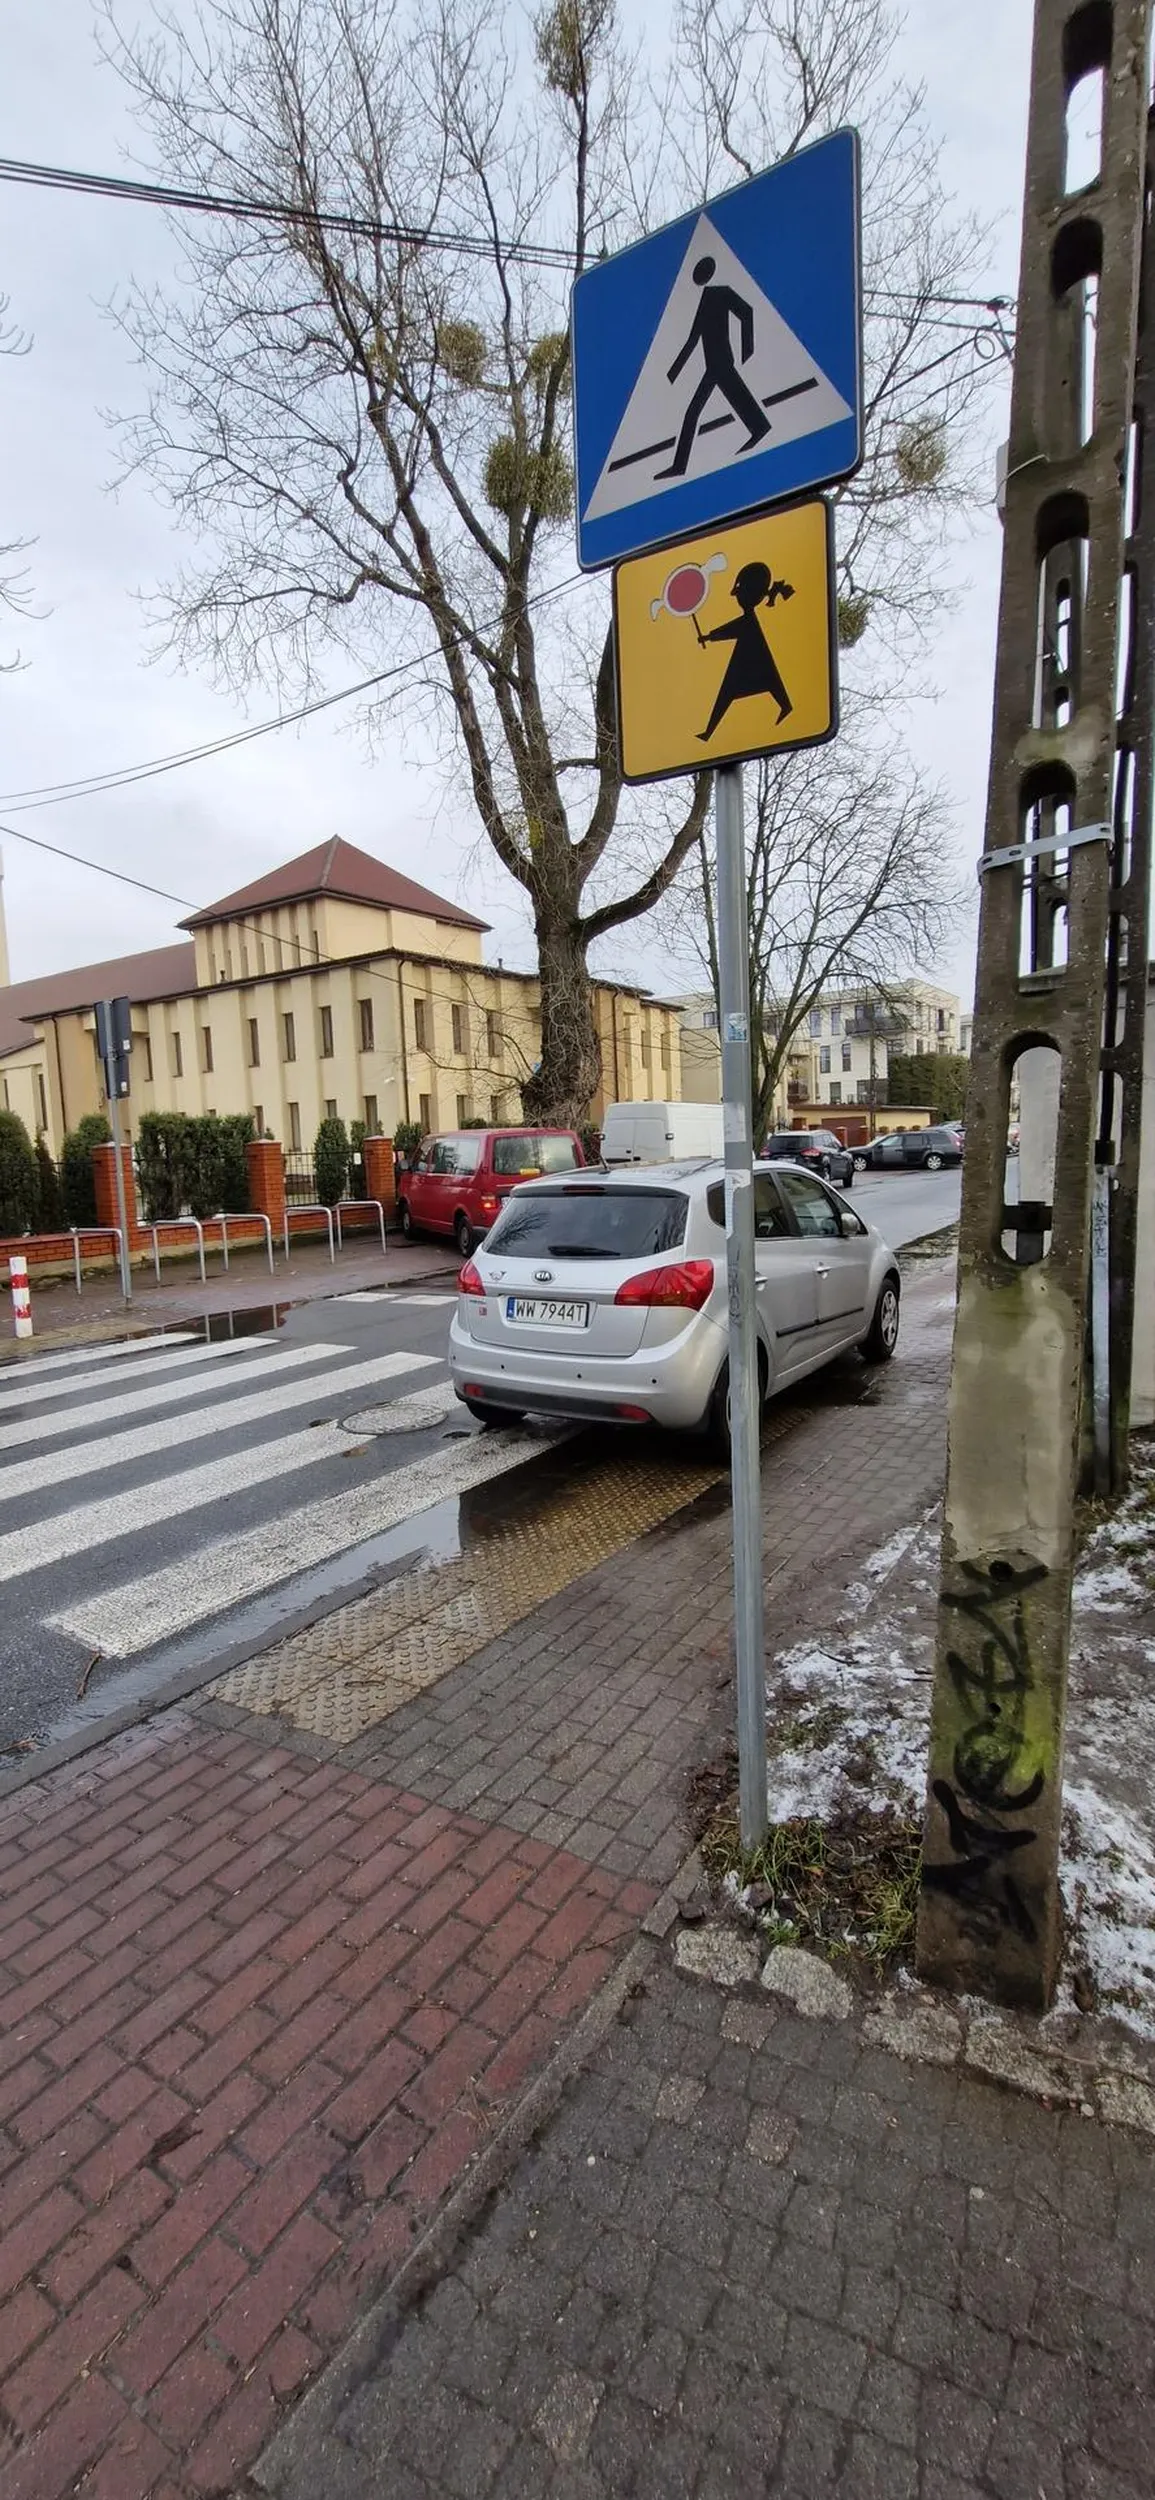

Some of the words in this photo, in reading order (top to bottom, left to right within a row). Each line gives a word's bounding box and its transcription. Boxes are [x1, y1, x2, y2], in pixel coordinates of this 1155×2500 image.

[535, 1271, 551, 1280] KIA
[516, 1302, 536, 1318] WW
[540, 1302, 585, 1321] 7944T
